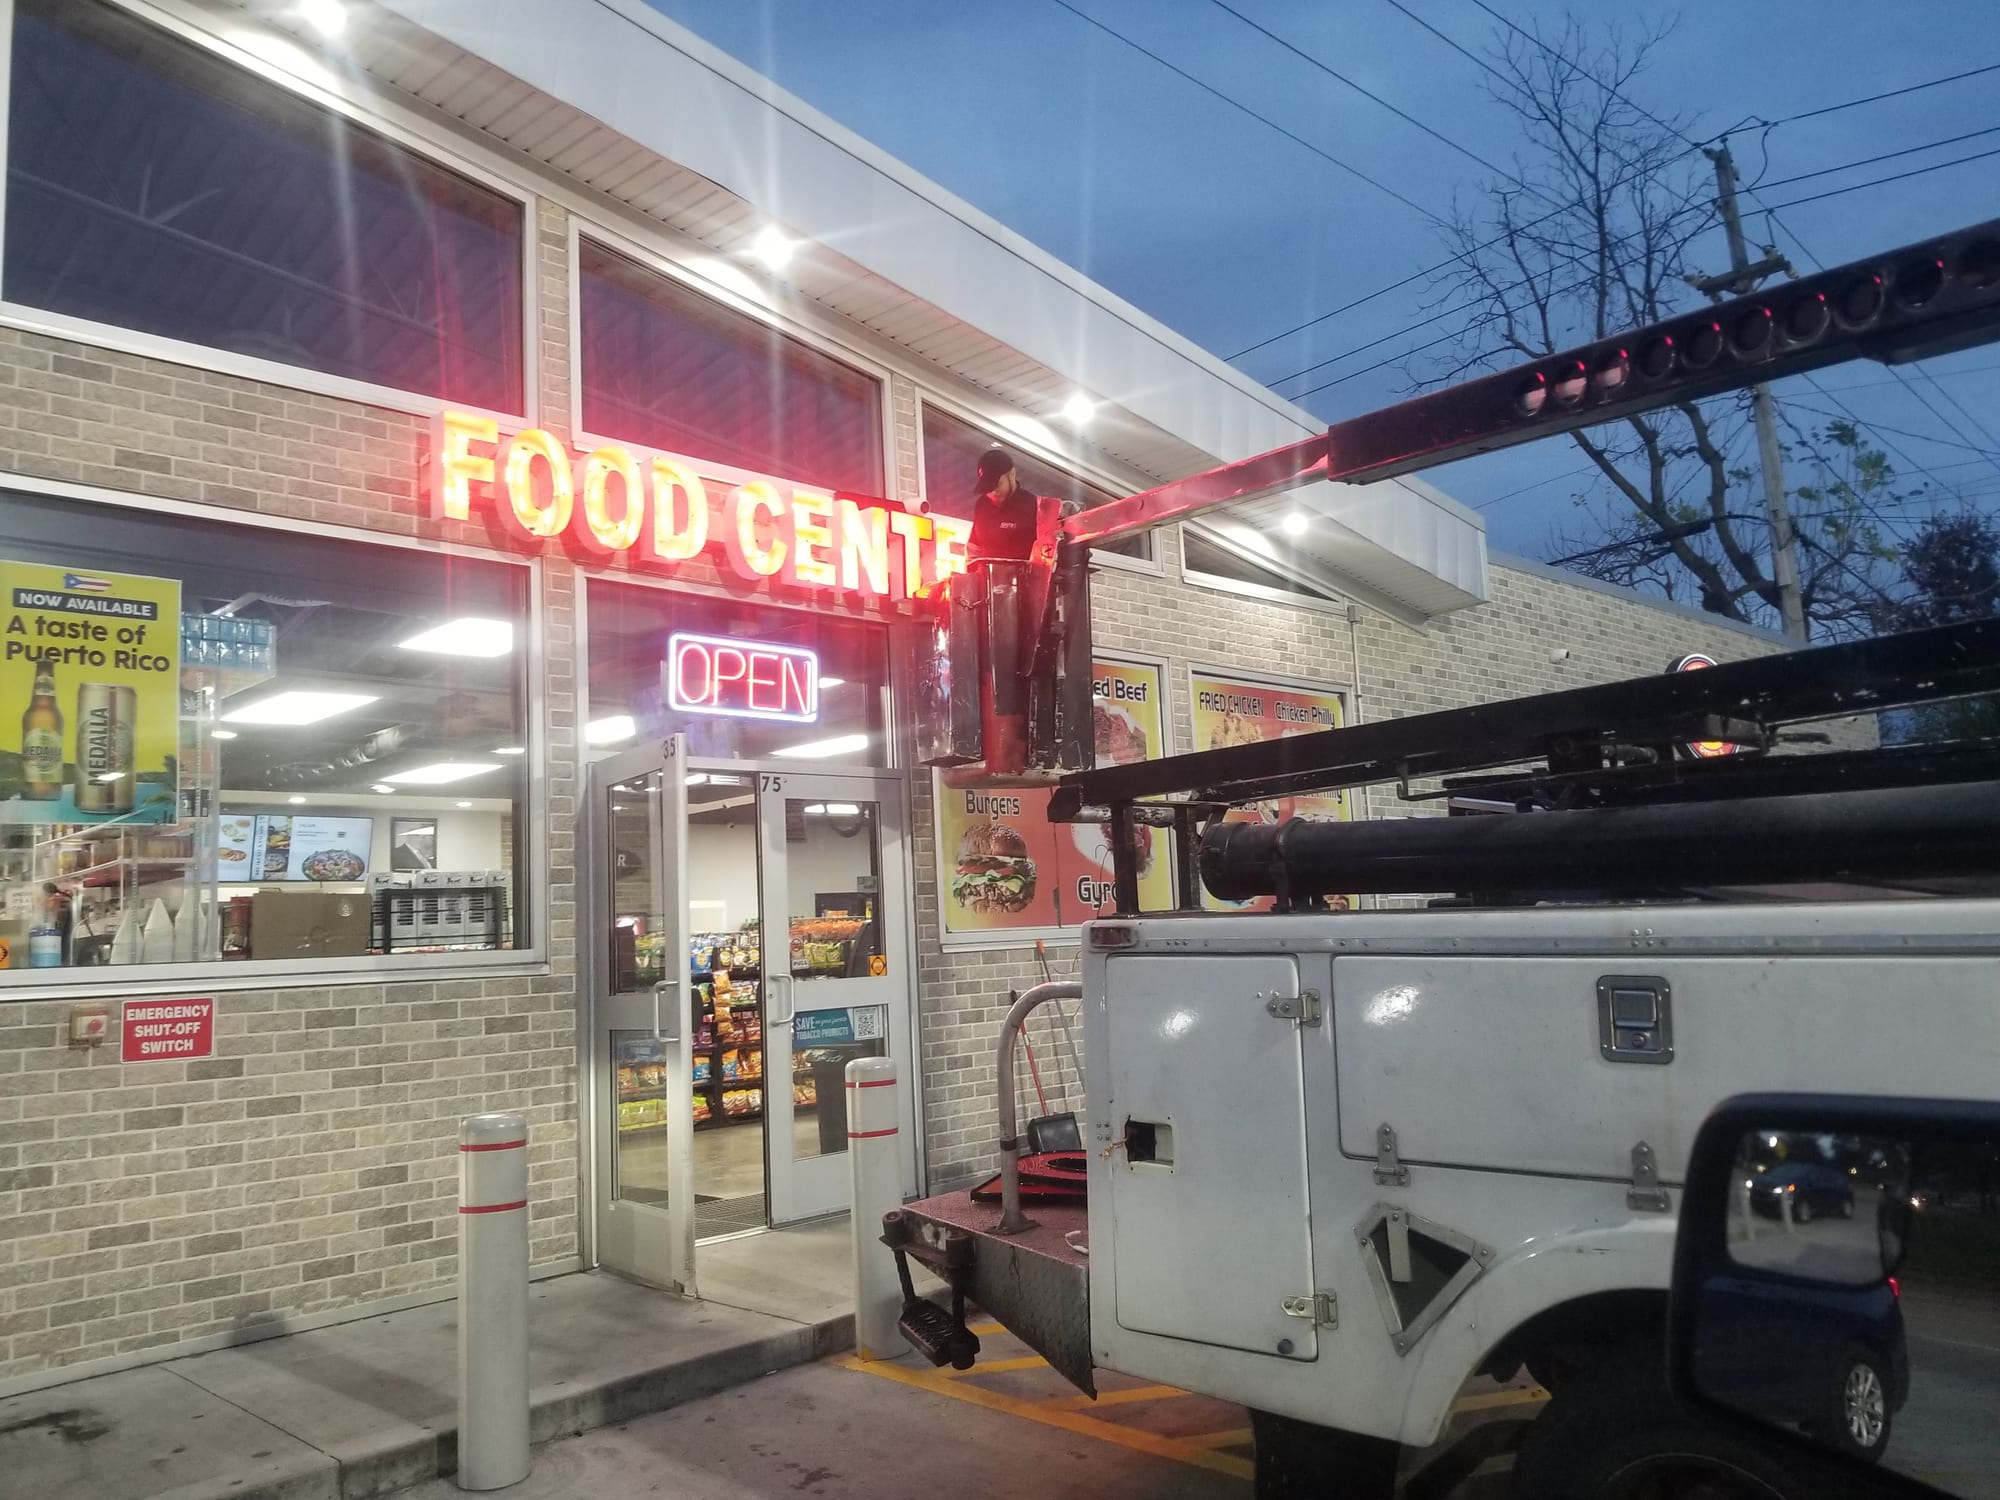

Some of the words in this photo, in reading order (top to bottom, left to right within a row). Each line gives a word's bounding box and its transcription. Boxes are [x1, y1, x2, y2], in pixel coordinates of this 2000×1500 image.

[437, 409, 708, 560] FOOD
[19, 592, 62, 607] NOW
[67, 598, 152, 617] AVAILABLE
[6, 615, 27, 635] A
[35, 615, 108, 642] taste
[116, 625, 146, 645] of
[6, 641, 105, 667] Puerto
[114, 648, 170, 672] Rico
[676, 642, 812, 715] OPEN
[1115, 679, 1147, 702] Beef
[1199, 691, 1226, 712] FRIED
[1228, 695, 1264, 717] CHICKEN
[1275, 702, 1310, 722] Chicken
[1312, 706, 1335, 730] Philly
[88, 707, 109, 787] MEDALLA
[761, 775, 781, 793] 75
[965, 789, 1020, 820] Burgers
[126, 1004, 210, 1021] EMERGENCY
[795, 1016, 816, 1031] SAVE
[135, 1022, 201, 1038] SHUT-OFF
[141, 1039, 194, 1054] SWITCH
